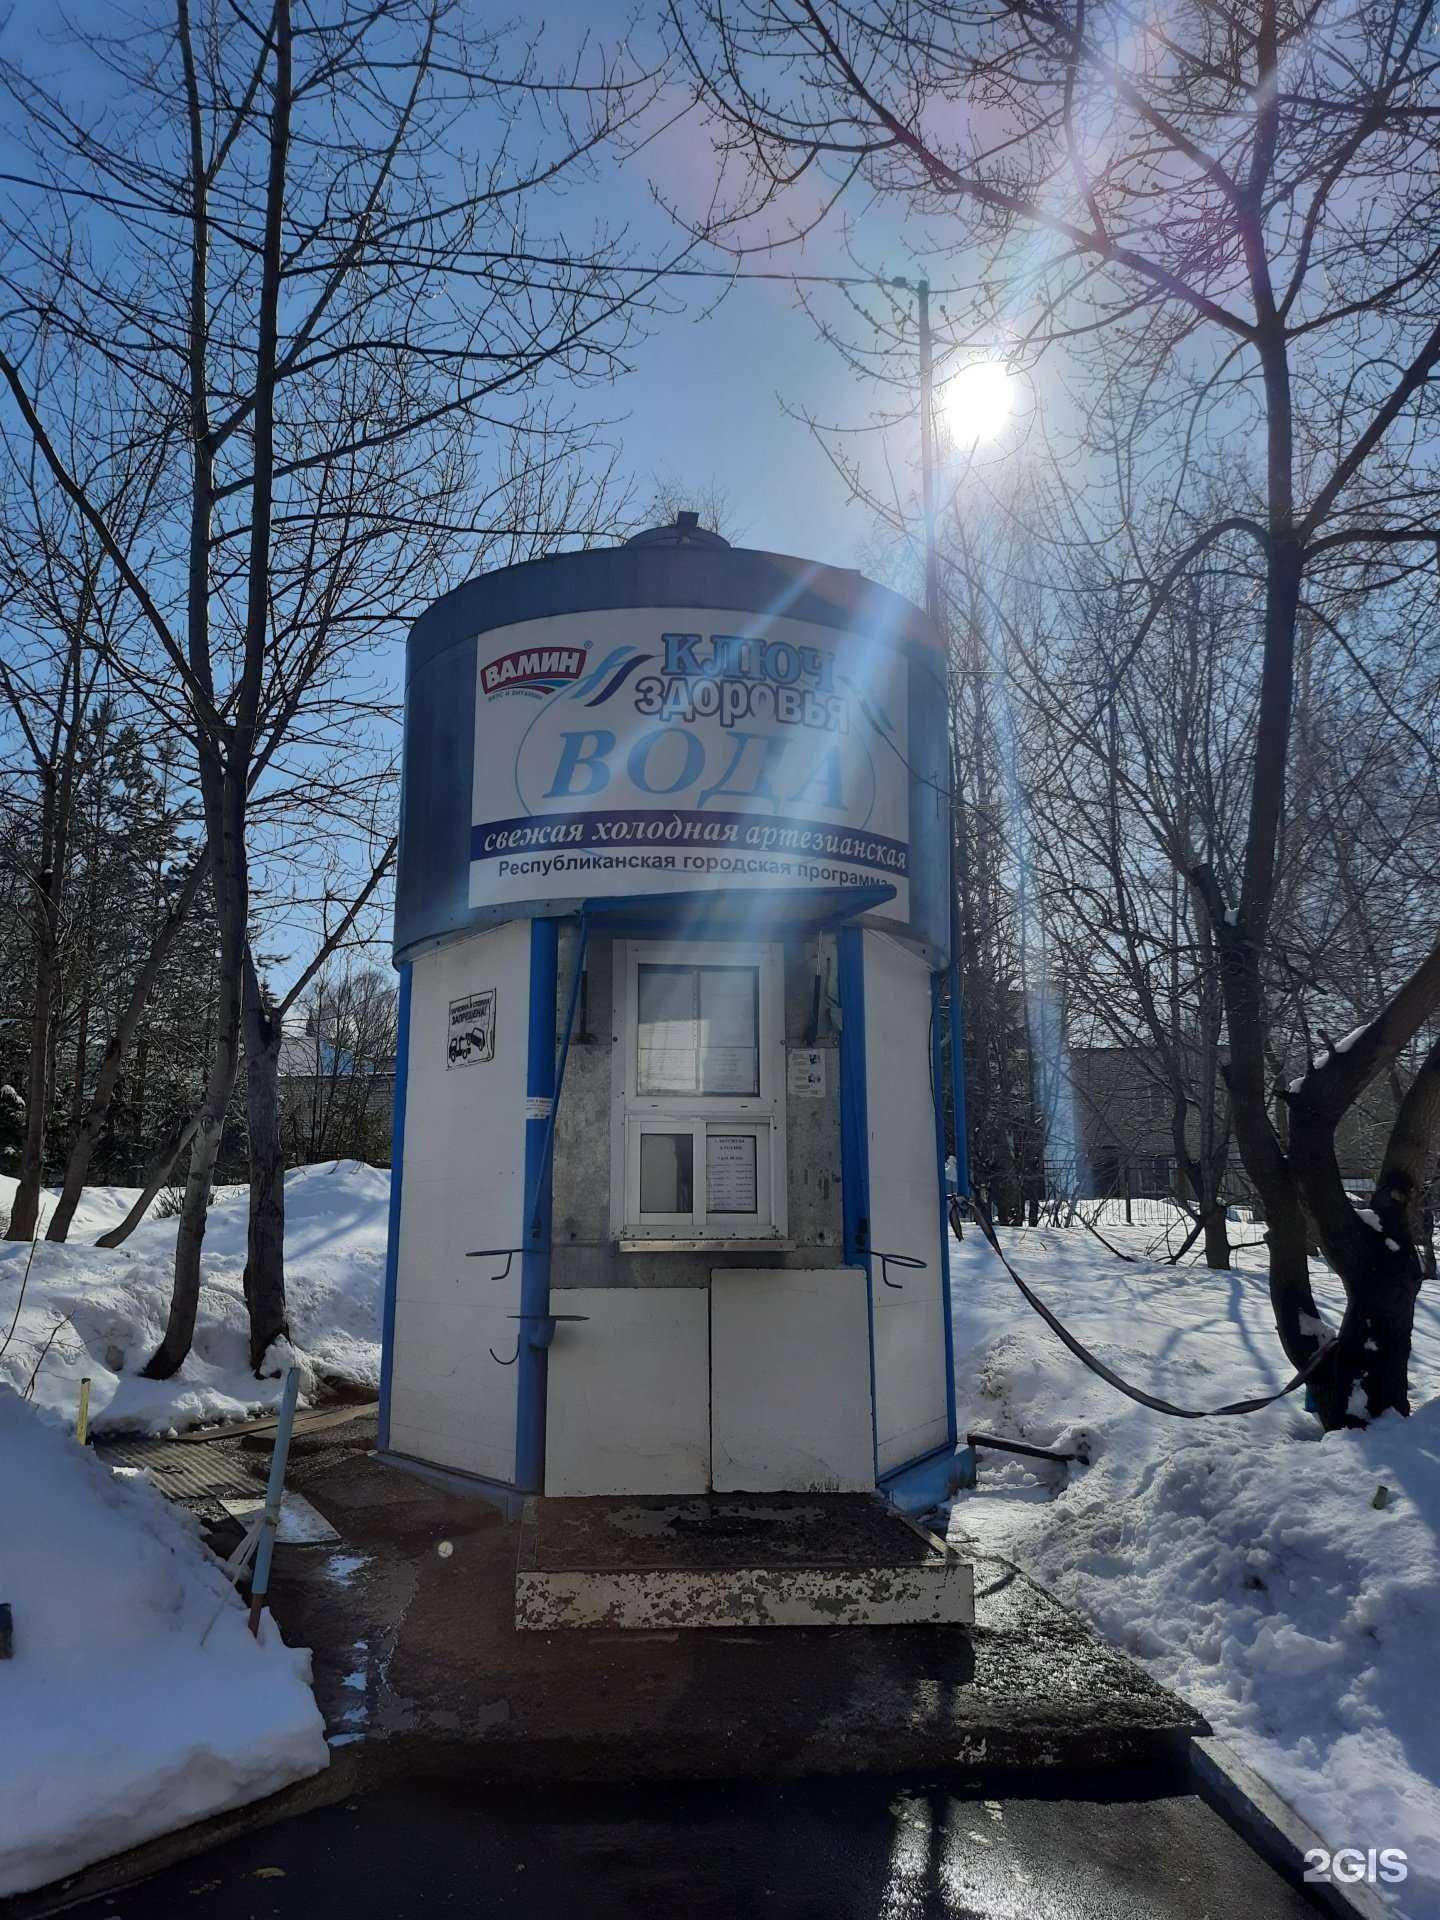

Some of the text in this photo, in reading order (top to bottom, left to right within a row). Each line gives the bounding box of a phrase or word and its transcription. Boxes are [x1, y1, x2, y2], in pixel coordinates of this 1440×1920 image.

[485, 651, 581, 689] ВАМИН
[661, 633, 834, 694] КЛЮЧ
[542, 727, 848, 814] ВОДА
[484, 813, 907, 869] свежая холодная артезианская
[498, 854, 676, 877] Республиканская
[683, 855, 791, 875] городская
